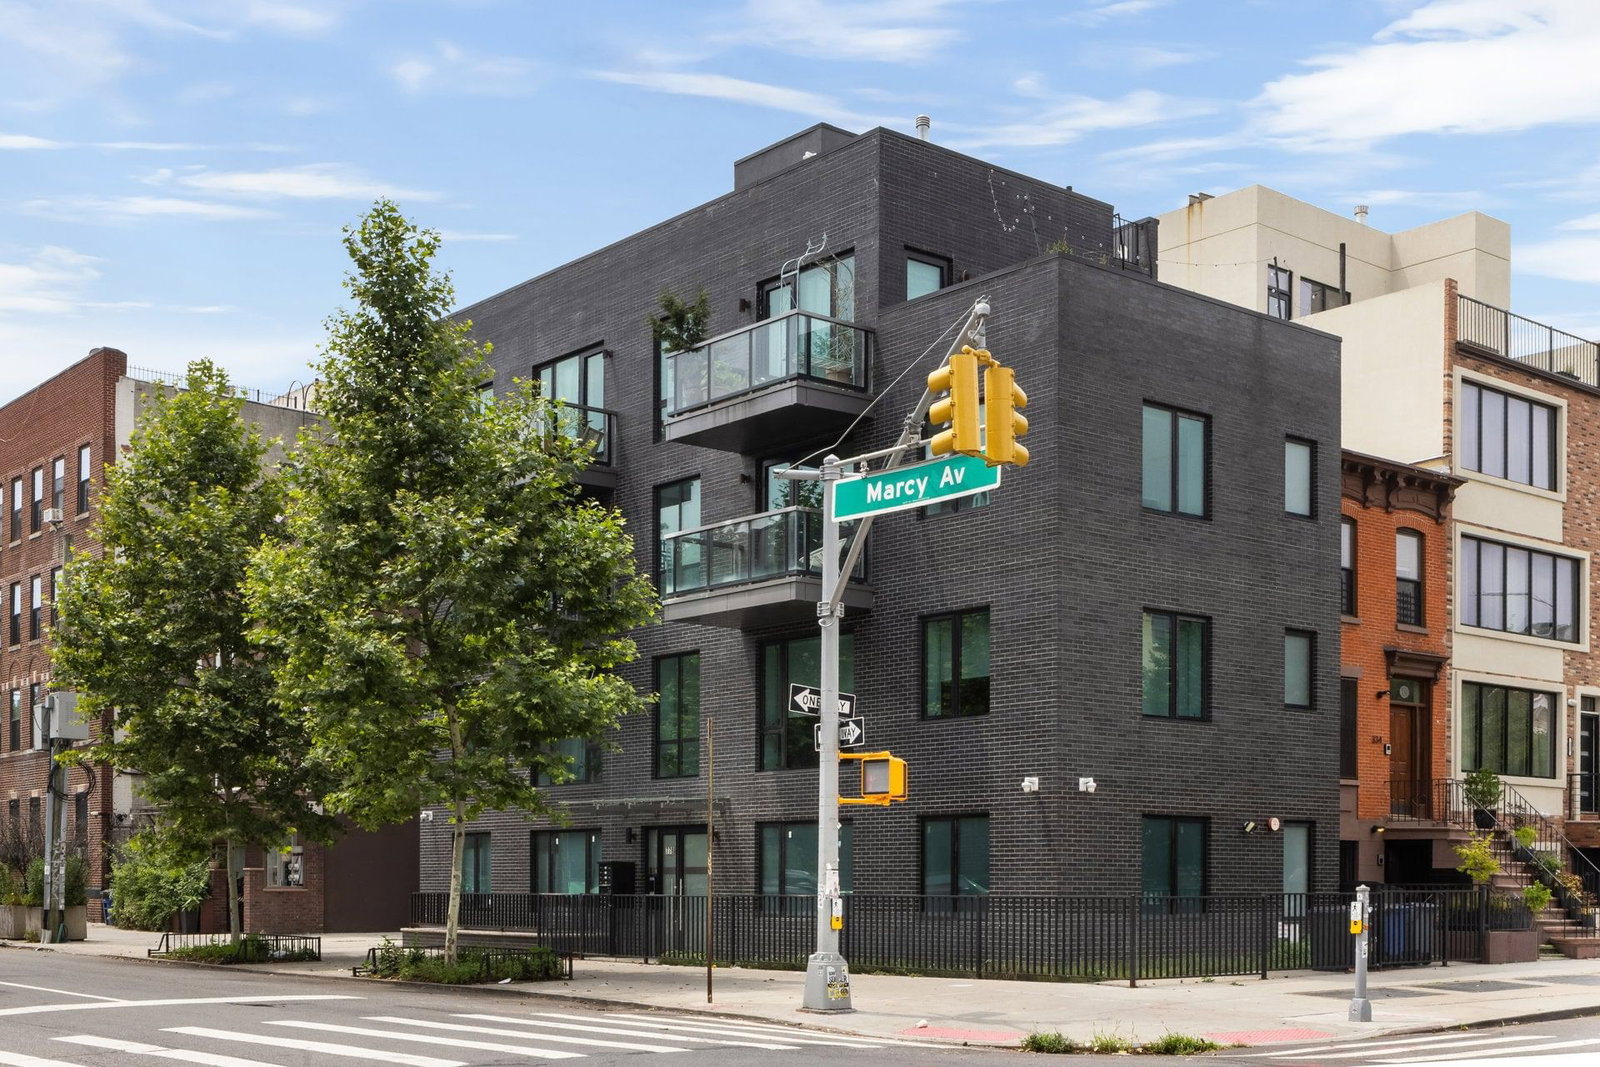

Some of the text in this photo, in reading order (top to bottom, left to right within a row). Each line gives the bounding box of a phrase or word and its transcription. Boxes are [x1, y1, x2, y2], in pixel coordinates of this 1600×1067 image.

[867, 466, 965, 503] Marcy Av
[802, 695, 821, 707] ONE
